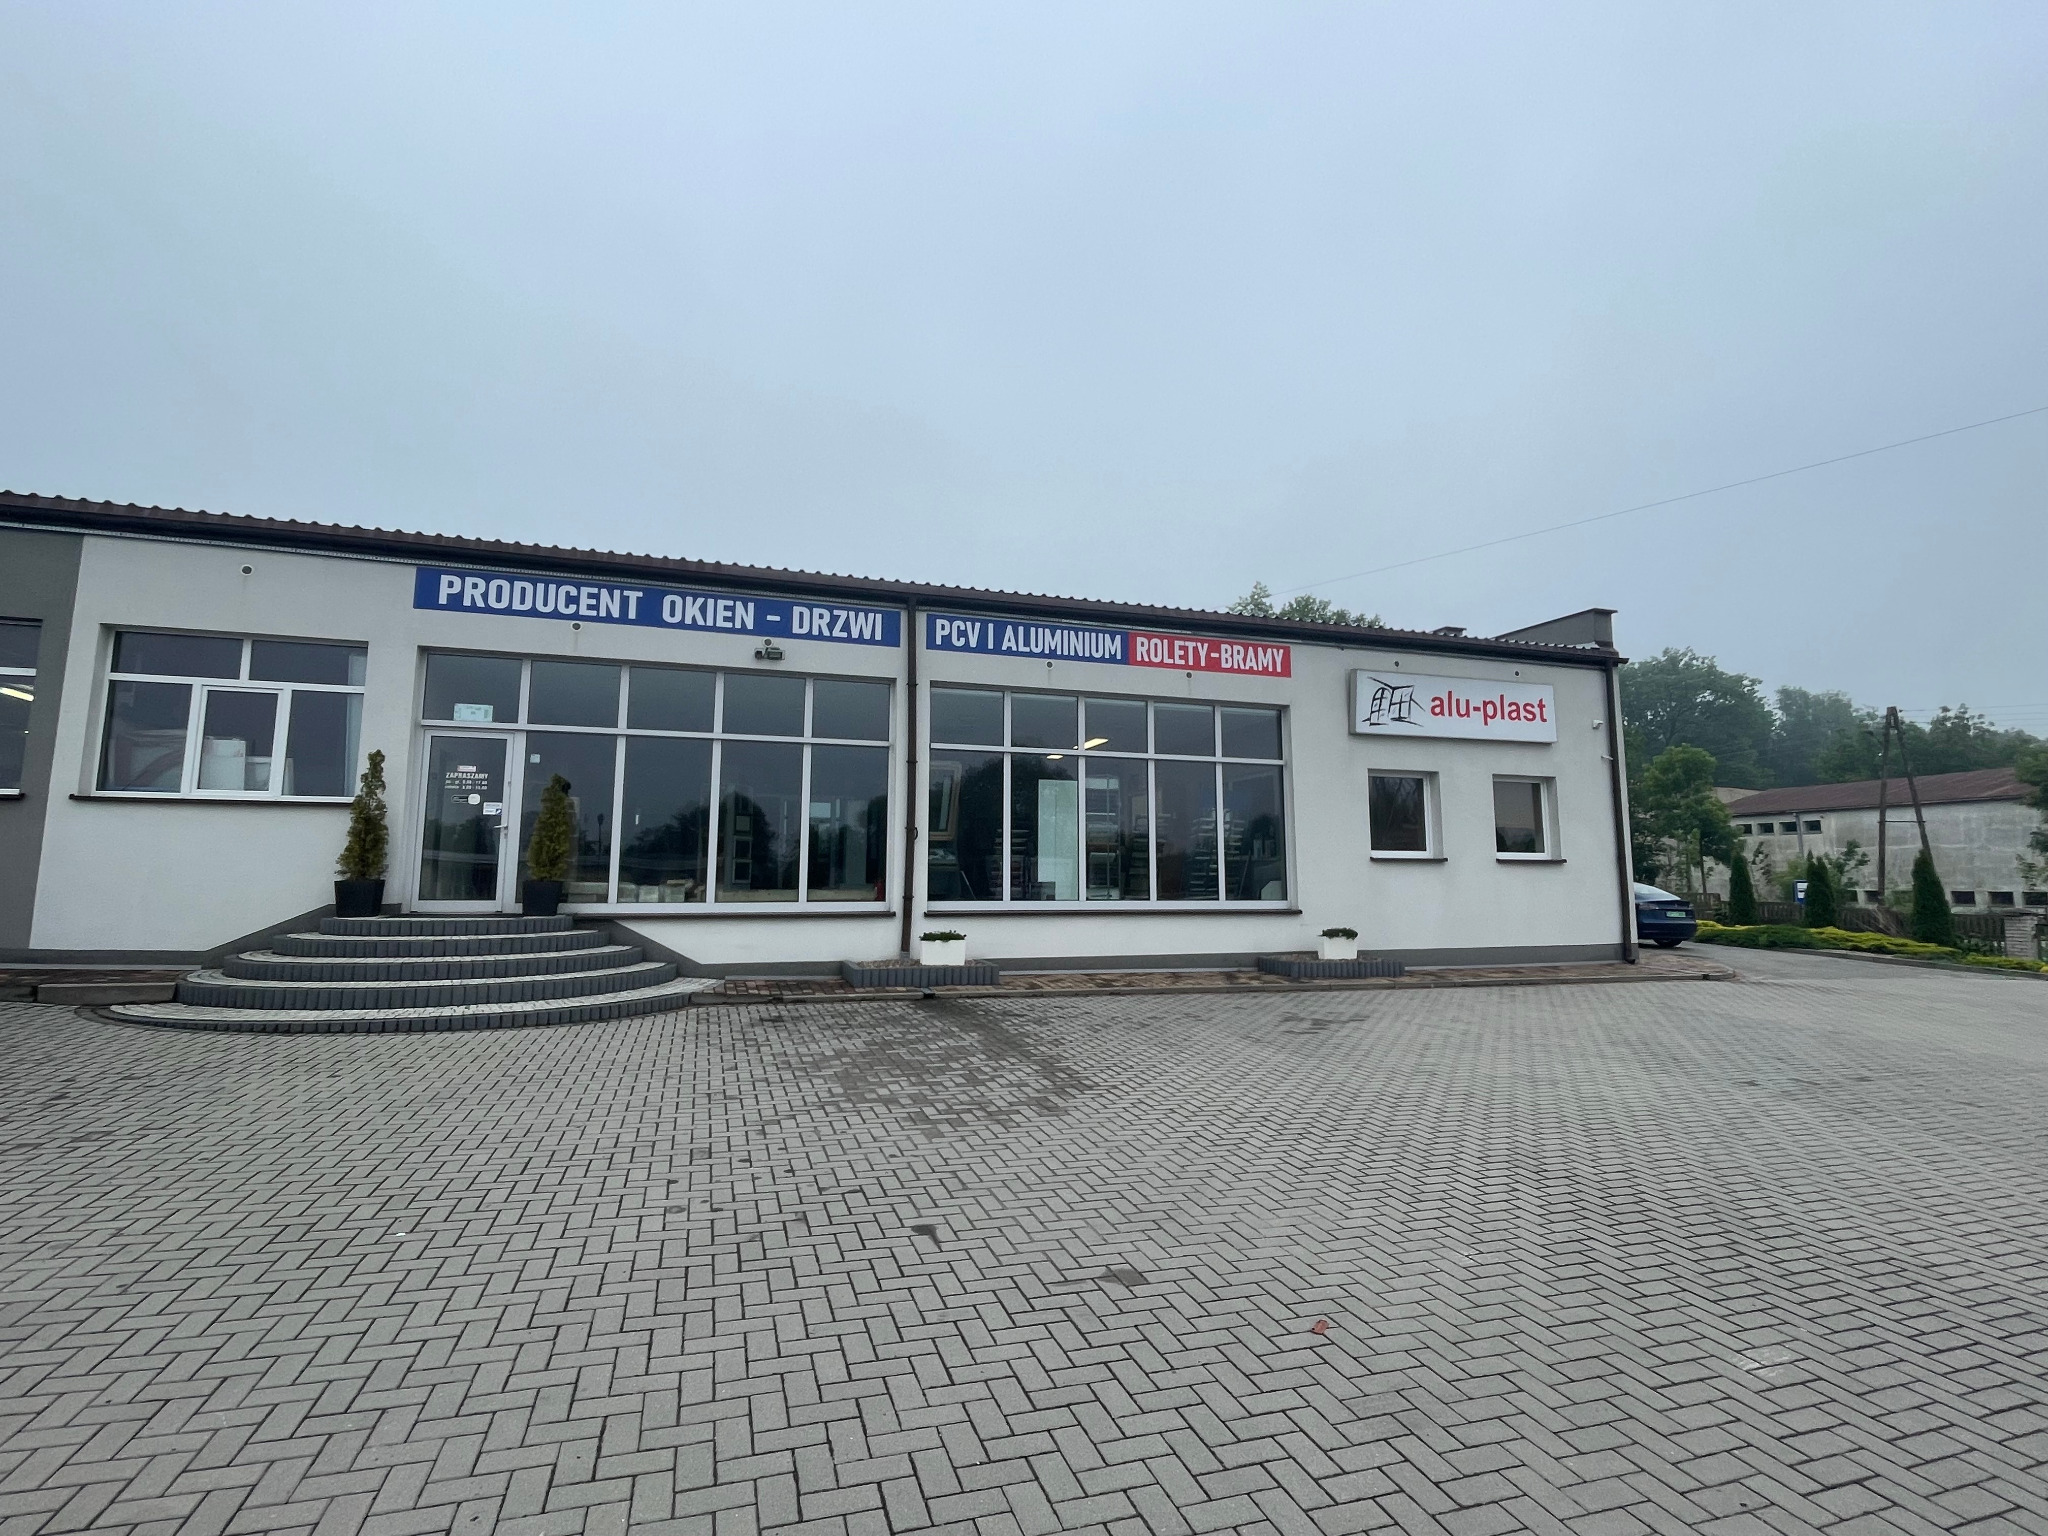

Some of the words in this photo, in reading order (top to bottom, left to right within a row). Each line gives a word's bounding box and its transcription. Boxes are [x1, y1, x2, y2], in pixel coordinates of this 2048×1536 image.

[438, 574, 644, 620] PRODUCENT
[662, 594, 755, 630] OKIEN
[792, 605, 883, 641] DRZWI
[935, 618, 980, 648] PCV
[988, 623, 994, 649] I
[1002, 625, 1122, 660] ALUMINIUM
[1430, 690, 1548, 726] alu-plast
